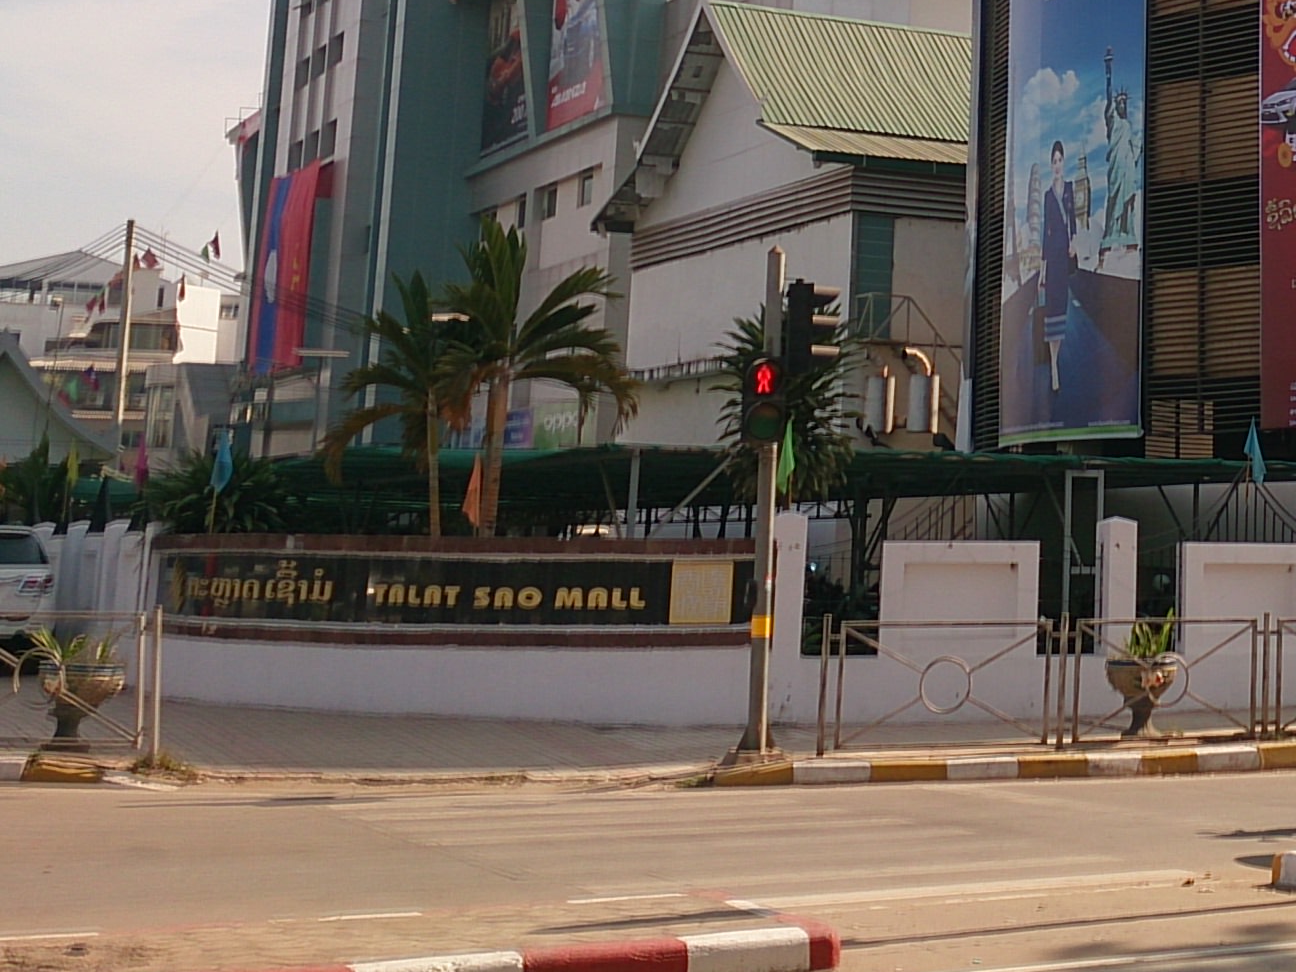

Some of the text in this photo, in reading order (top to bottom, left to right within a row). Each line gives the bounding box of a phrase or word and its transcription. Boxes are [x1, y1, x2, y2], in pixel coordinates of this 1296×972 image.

[373, 583, 460, 607] TALAT
[473, 586, 543, 610] SAO
[554, 587, 646, 611] MALL
